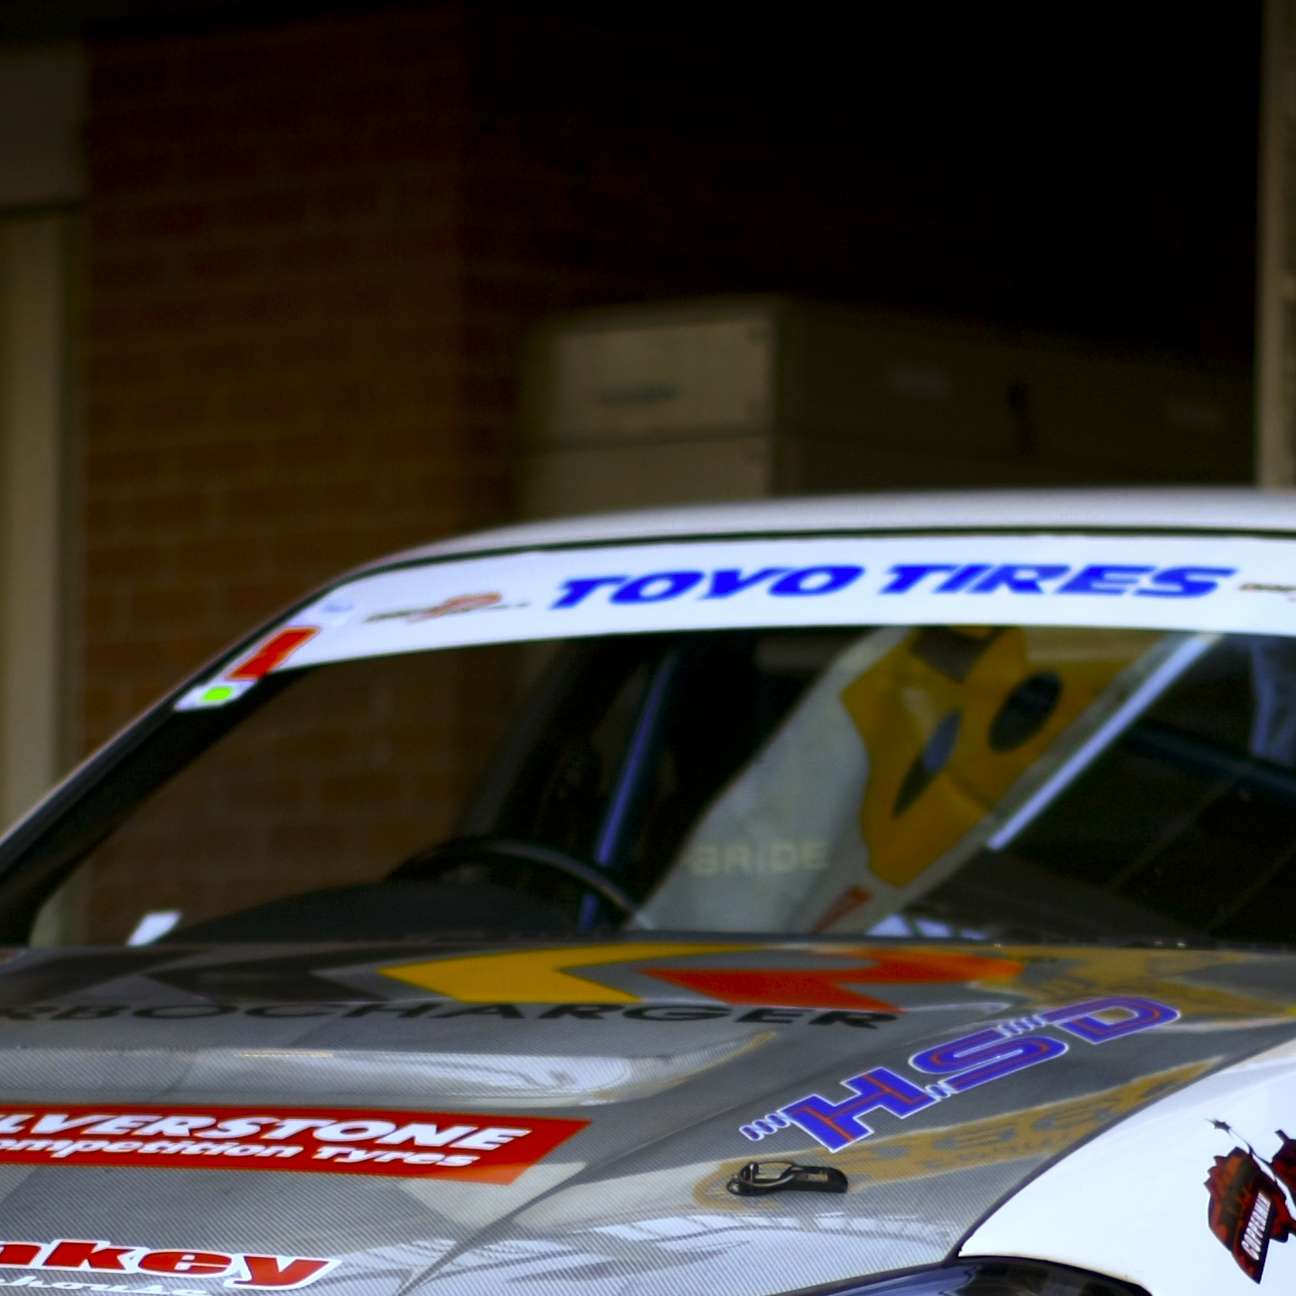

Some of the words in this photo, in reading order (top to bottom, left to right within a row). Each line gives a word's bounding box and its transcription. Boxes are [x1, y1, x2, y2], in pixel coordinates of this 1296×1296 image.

[548, 564, 865, 610] TOYO
[877, 563, 1239, 600] TIRES
[740, 996, 1181, 1152] HSD
[311, 1145, 482, 1168] Tyres
